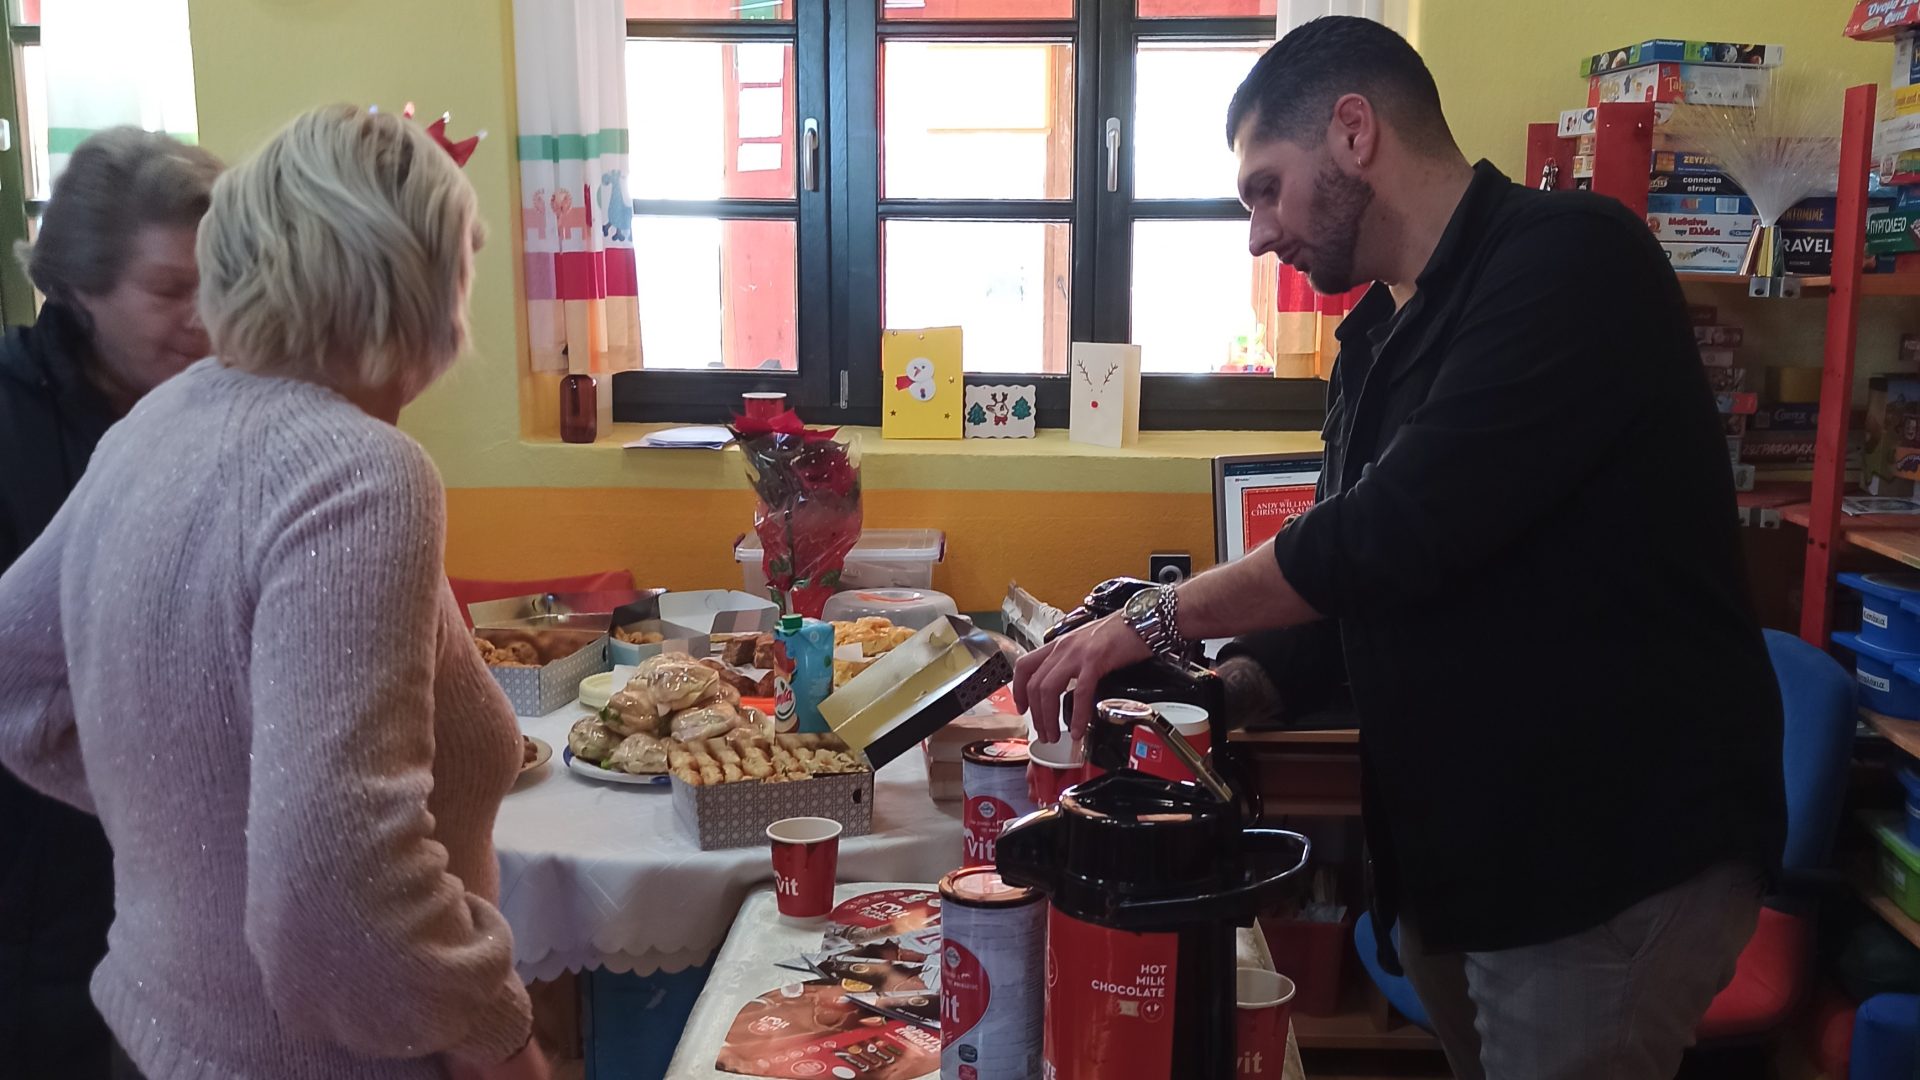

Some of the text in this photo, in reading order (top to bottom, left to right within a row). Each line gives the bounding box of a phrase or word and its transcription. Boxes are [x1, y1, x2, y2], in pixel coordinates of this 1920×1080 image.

[1682, 176, 1722, 184] connecta
[1687, 184, 1716, 192] straws
[1782, 236, 1832, 253] RAVEL
[1256, 499, 1315, 510] ANDY WILLIAM
[1251, 507, 1296, 517] CHRISTMAS
[1140, 964, 1168, 975] HOT
[1136, 975, 1166, 986] MILK
[1091, 979, 1166, 998] CHOCOLATE
